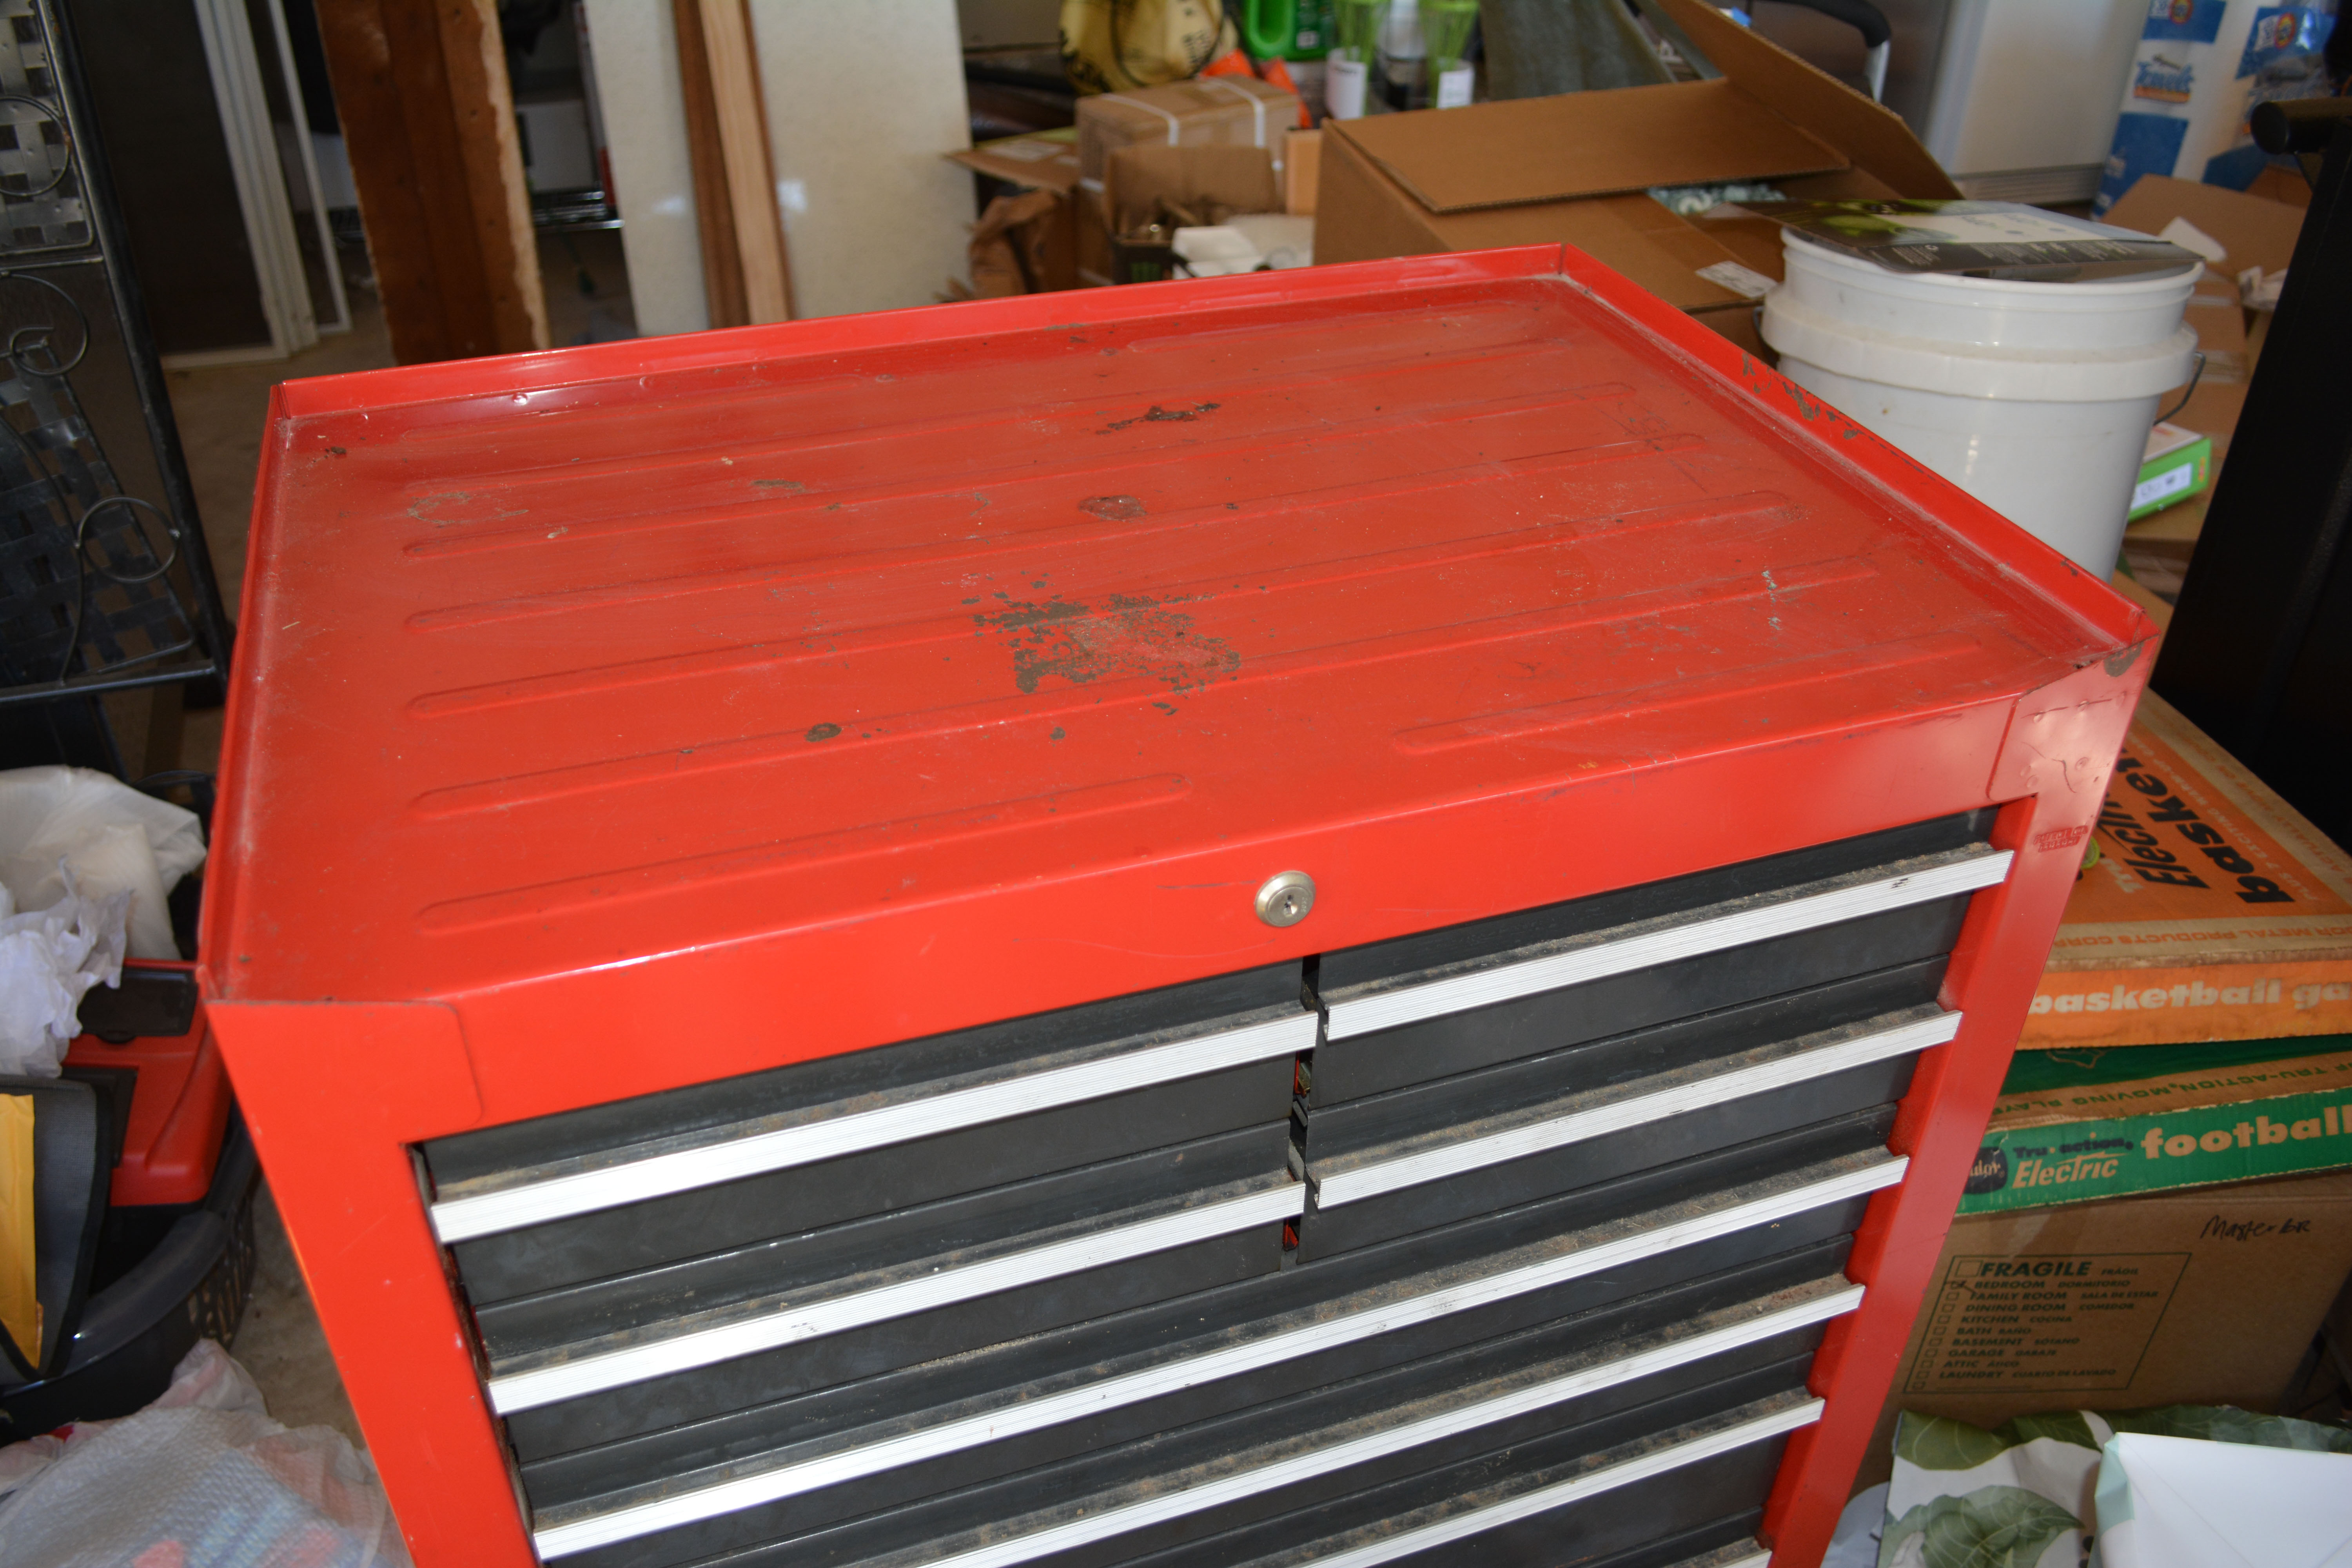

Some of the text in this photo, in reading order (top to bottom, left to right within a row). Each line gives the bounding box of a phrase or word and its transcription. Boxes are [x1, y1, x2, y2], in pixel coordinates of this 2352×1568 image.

[2238, 927, 2312, 938] METAL
[2118, 931, 2238, 945] PRODUCTS
[2141, 1104, 2352, 1160] football
[2011, 1151, 2129, 1189] Electric
[1980, 1261, 2093, 1277] FRAGILE
[1974, 1279, 2131, 1289] BEDROOM DORMITORIO
[1970, 1292, 2017, 1301] FAMILY
[2022, 1292, 2067, 1300] ROOM
[1965, 1303, 2018, 1312] DINING
[2021, 1303, 2066, 1312] ROOM
[1961, 1315, 2019, 1323] KITCHEN
[1952, 1338, 2024, 1346] BASEMENT
[1948, 1349, 2005, 1357] GARAGE
[1939, 1371, 2004, 1379] LAUNDRY
